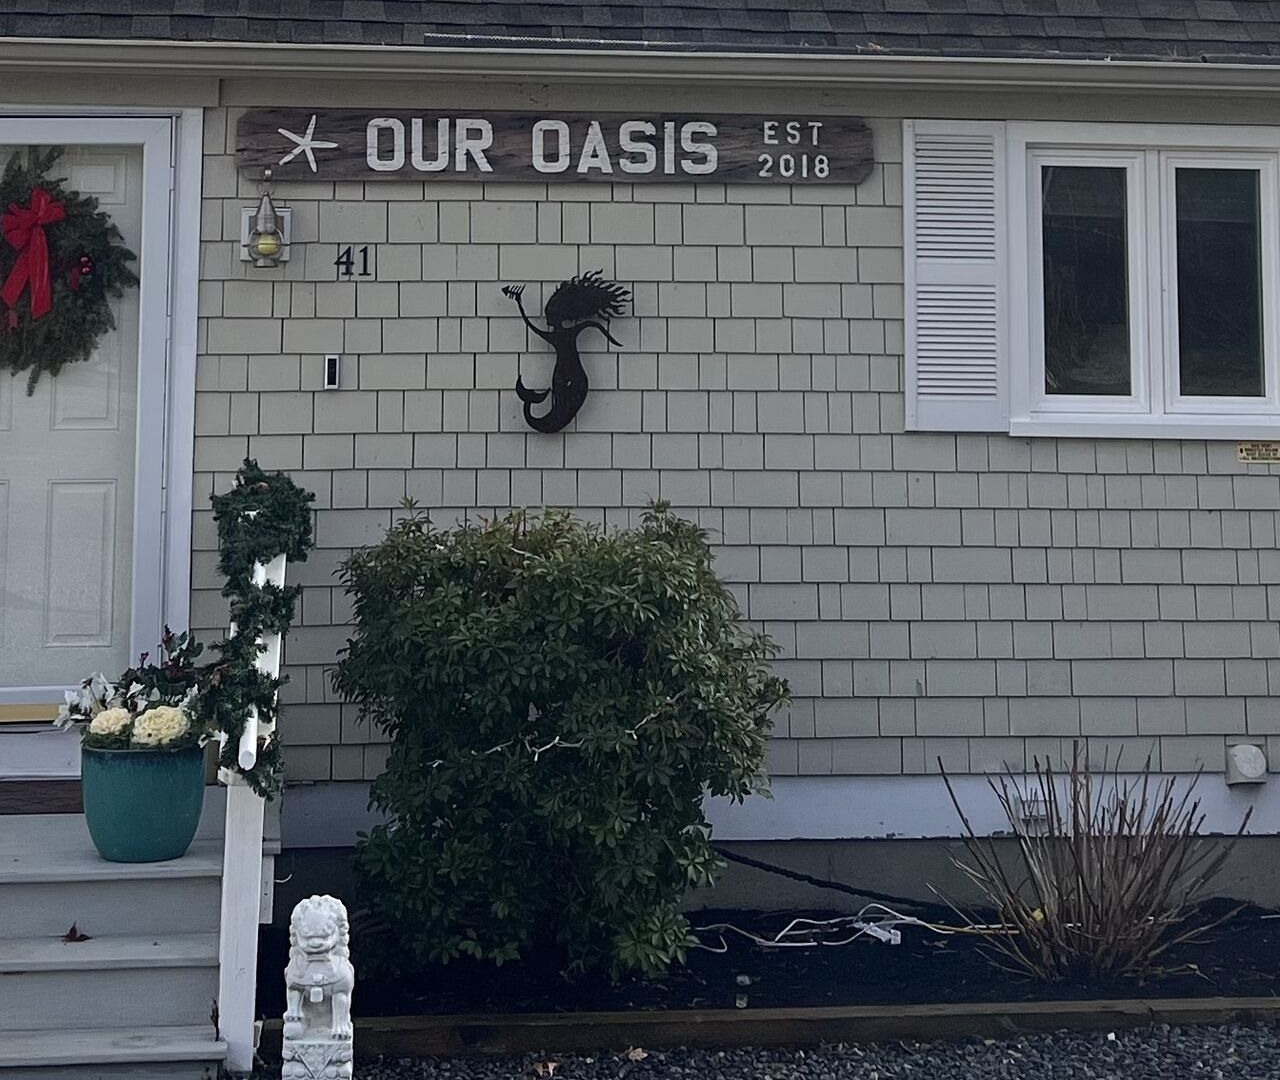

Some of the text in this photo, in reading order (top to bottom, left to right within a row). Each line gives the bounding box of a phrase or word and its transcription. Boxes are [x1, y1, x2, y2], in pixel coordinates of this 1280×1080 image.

[366, 117, 718, 175] OUR OASIS
[763, 121, 824, 146] EST
[757, 153, 830, 179] 2018
[333, 245, 372, 276] 41
